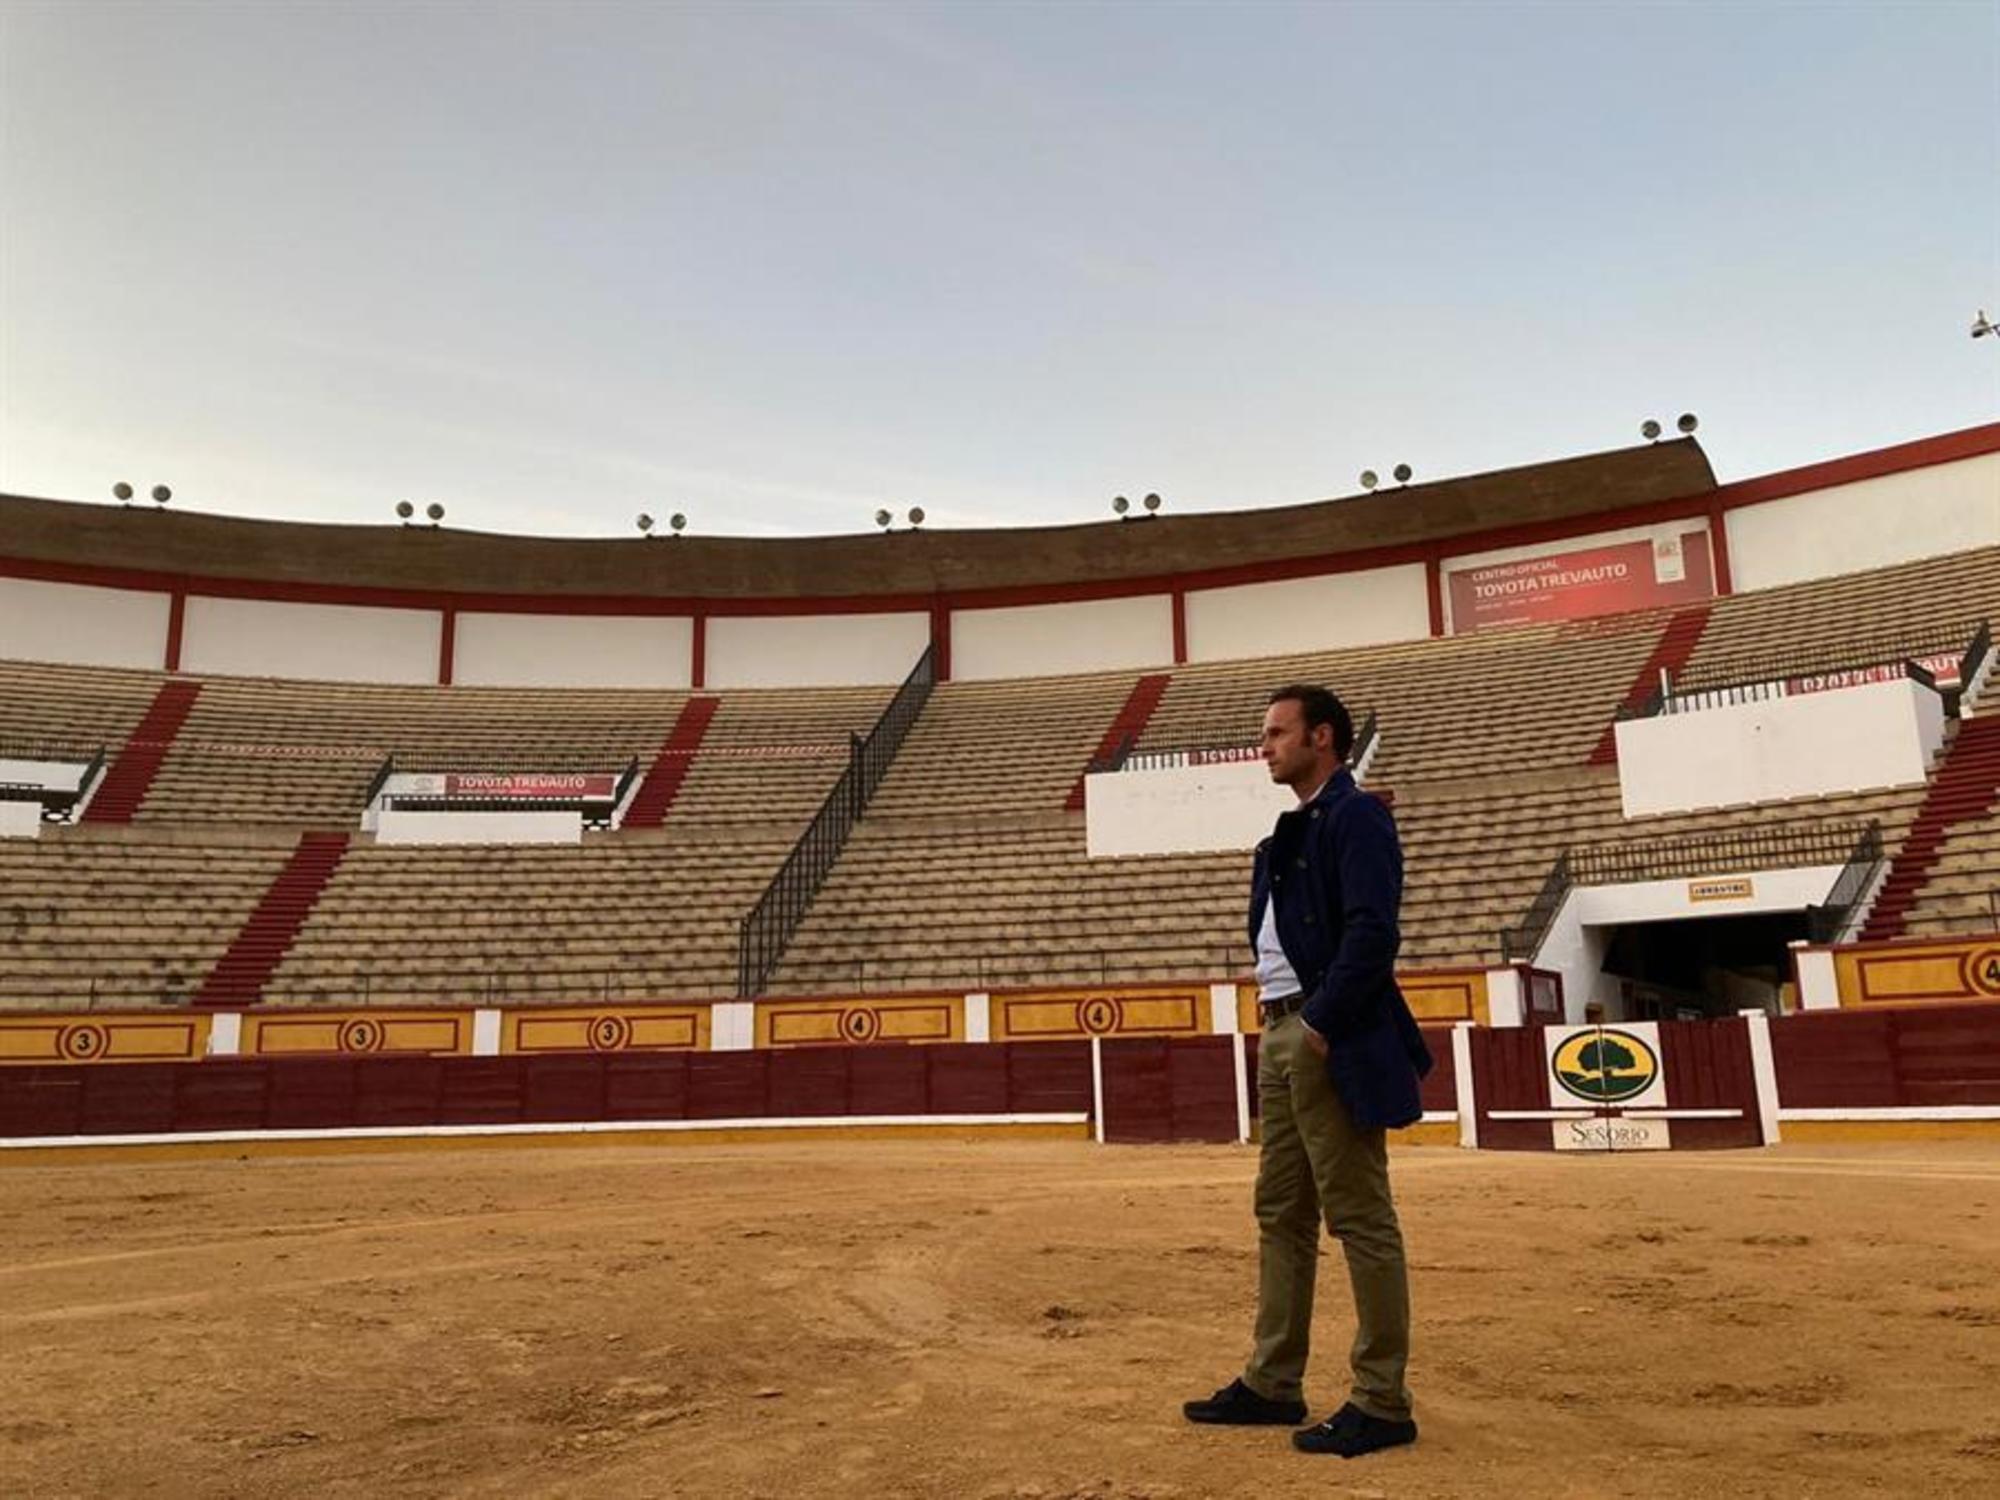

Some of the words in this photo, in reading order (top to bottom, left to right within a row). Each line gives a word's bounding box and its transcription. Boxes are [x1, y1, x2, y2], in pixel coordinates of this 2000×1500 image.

[1472, 567, 1516, 582] CENTRO
[1517, 558, 1560, 576] OFICIAL
[1474, 576, 1539, 599] TOYOTA
[1539, 562, 1628, 589] TREVAUTO
[457, 775, 512, 789] TOYOTA
[513, 775, 586, 789] TREVAUTO
[853, 1015, 864, 1033] 4
[1093, 1005, 1103, 1026] 4
[355, 1028, 366, 1046] 3
[603, 1023, 614, 1041] 3
[77, 1033, 91, 1051] 3
